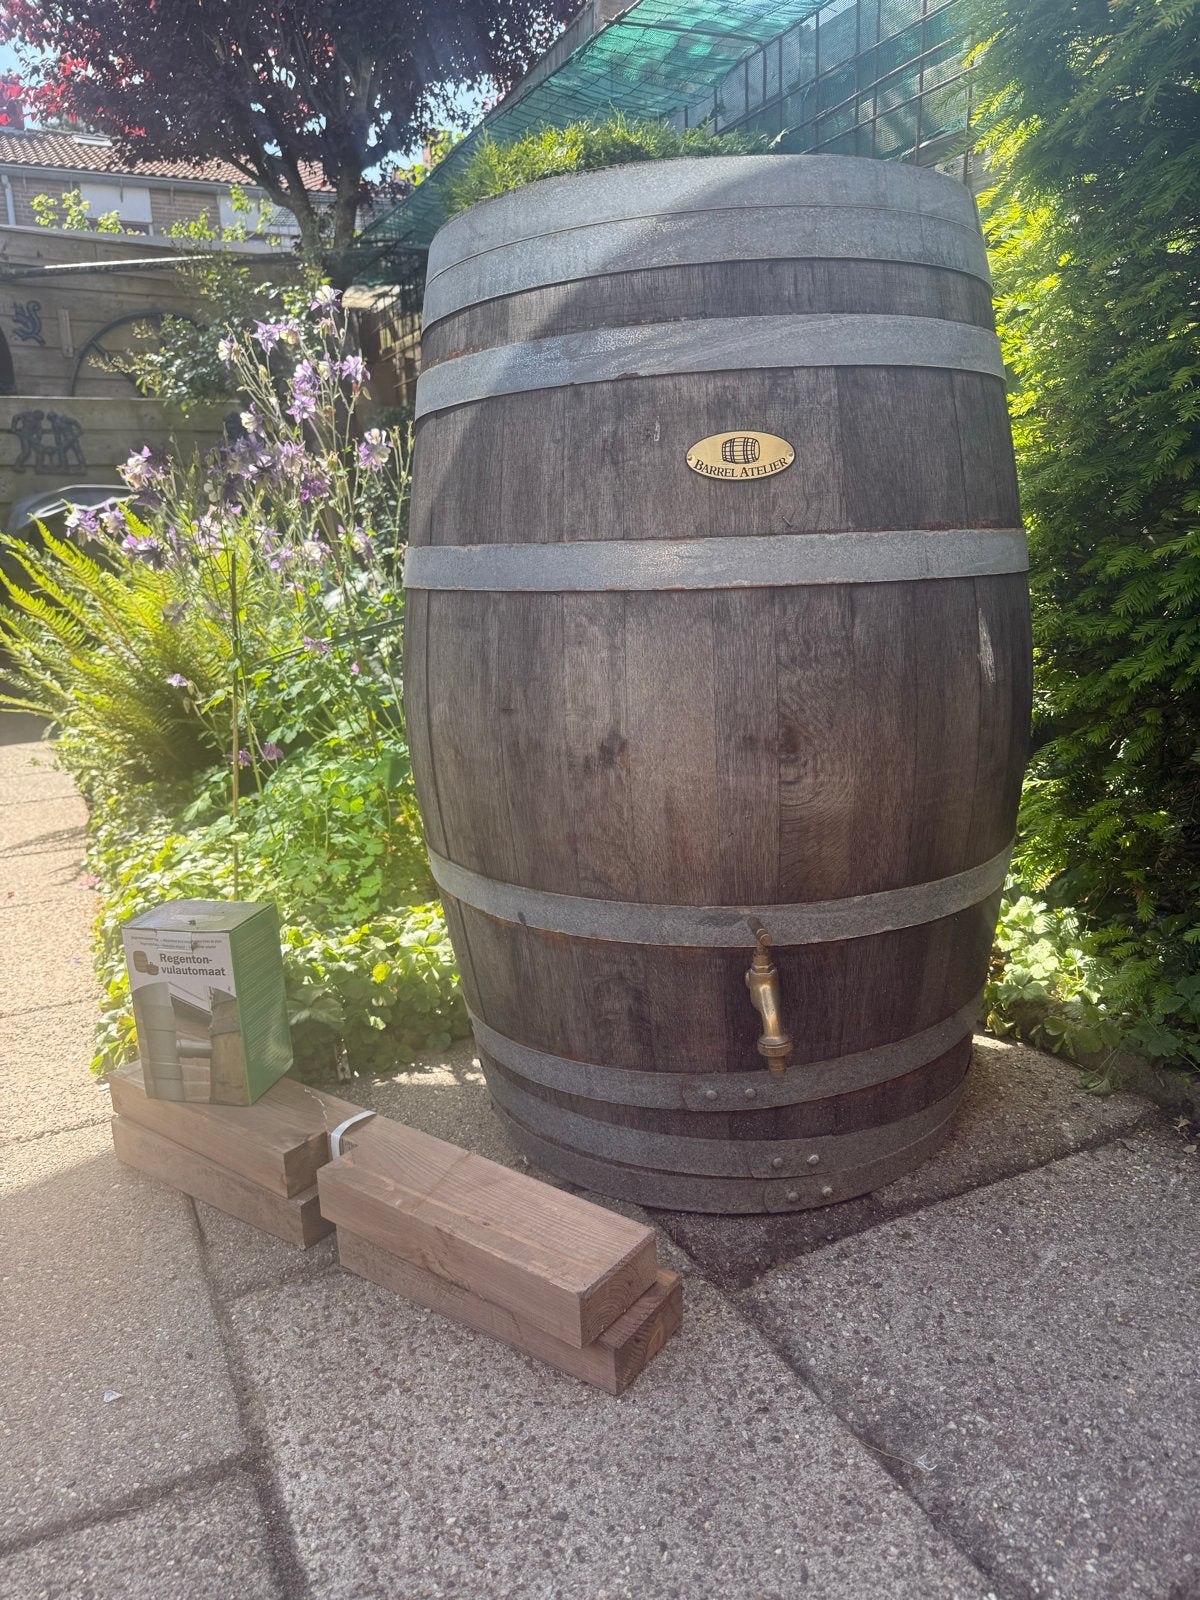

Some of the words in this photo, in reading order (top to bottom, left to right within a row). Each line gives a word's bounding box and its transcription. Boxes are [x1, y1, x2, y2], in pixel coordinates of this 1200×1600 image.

[694, 459, 738, 477] BARREL
[740, 457, 788, 478] ATELIER
[160, 953, 213, 965] Regenton-
[161, 965, 226, 976] vulautomaat
